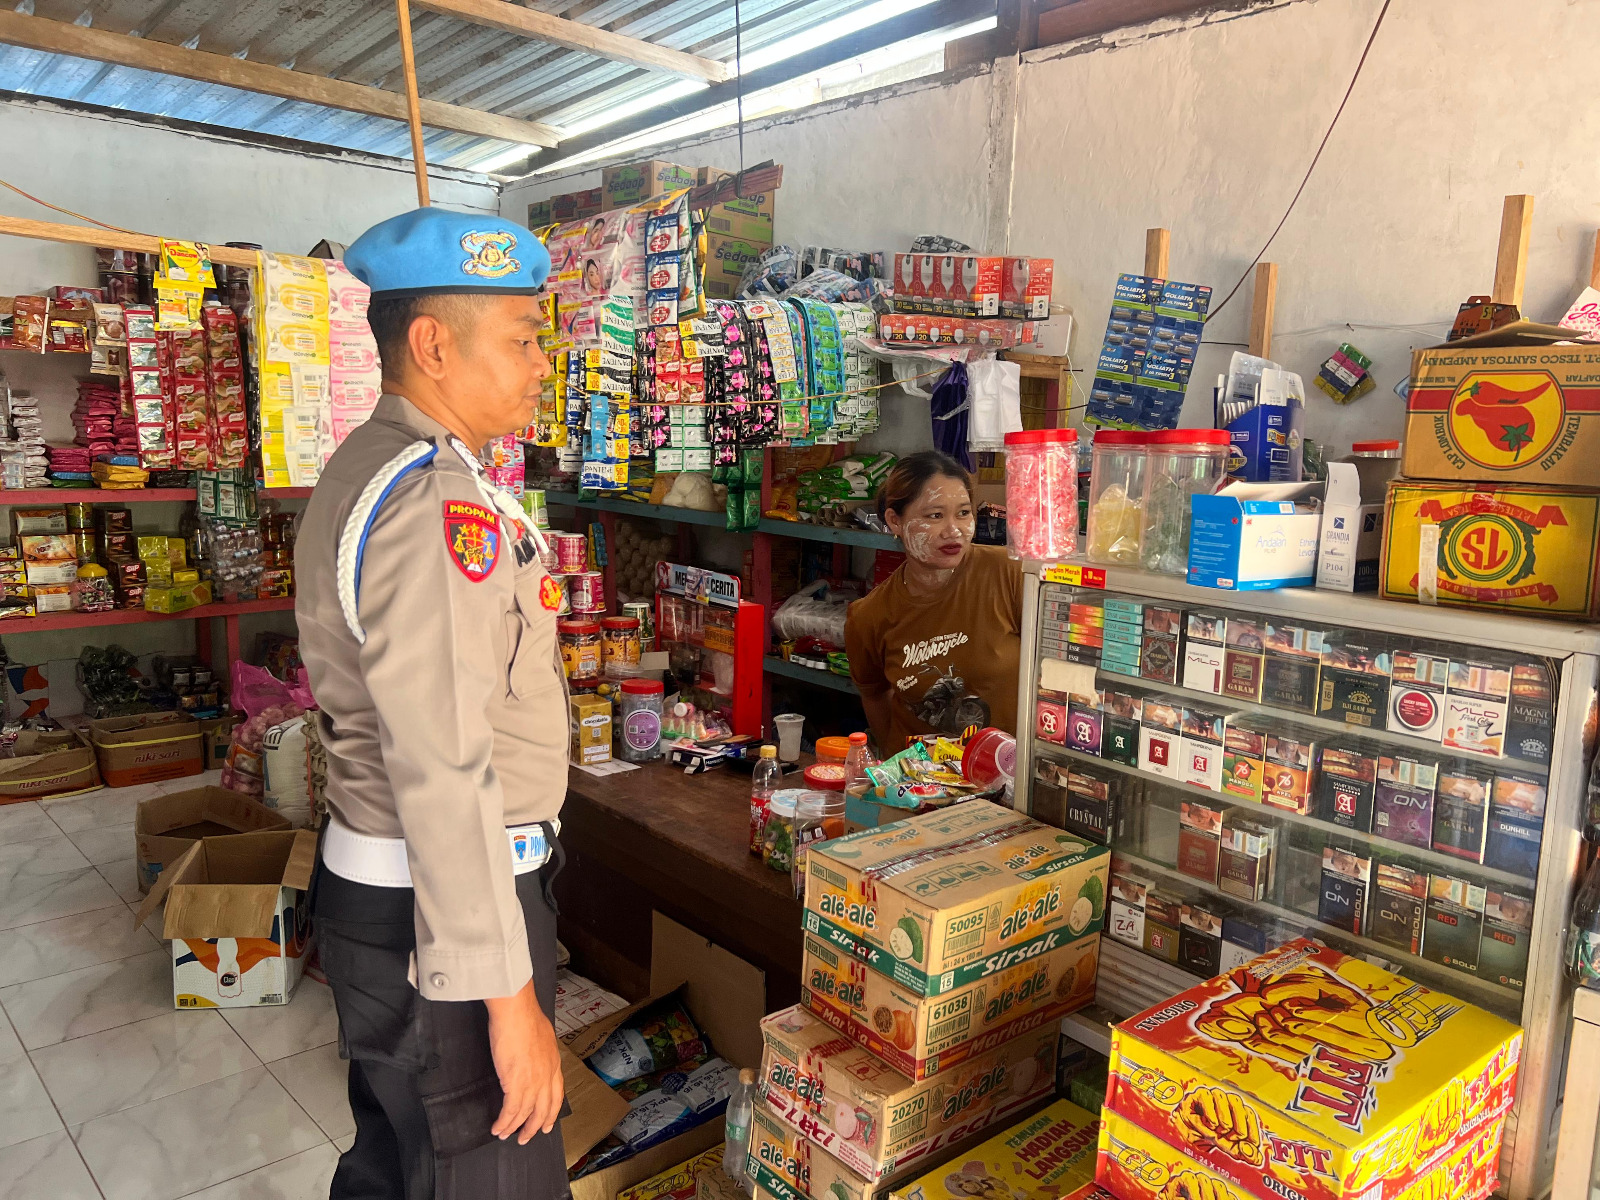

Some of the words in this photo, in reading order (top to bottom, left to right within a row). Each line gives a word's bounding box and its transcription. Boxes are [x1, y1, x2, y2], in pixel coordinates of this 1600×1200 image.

[1424, 356, 1478, 366] AMPENAN
[1481, 355, 1537, 365] SANTOSA
[1540, 353, 1581, 365] TESCO
[1433, 415, 1451, 455] LOMBOK
[1540, 416, 1581, 472] TEMBAKAU
[584, 465, 614, 474] PANTENE
[448, 504, 496, 525] PROPAM
[1325, 563, 1344, 572] P104
[710, 577, 735, 599] CERITA
[1227, 682, 1255, 694] GARAM
[1450, 704, 1499, 719] MLD
[134, 750, 156, 763] niki
[158, 749, 181, 761] sari
[1235, 763, 1248, 776] 76
[1278, 774, 1292, 788] 76
[1333, 781, 1361, 793] SAMPOERNA
[1276, 790, 1292, 799] APEL
[1393, 793, 1428, 810] ON
[1069, 807, 1104, 830] CRYSTAL
[1500, 823, 1531, 837] DUNHILL
[1325, 890, 1350, 907] ON
[1354, 888, 1363, 918] BOLD
[808, 917, 818, 931] 15
[948, 912, 985, 936] 50095
[1380, 908, 1407, 925] ON
[1412, 905, 1422, 937] BOLD
[1437, 912, 1458, 926] RED
[1493, 930, 1515, 945] RED
[1452, 958, 1477, 971] BOLD
[941, 977, 952, 989] 15
[933, 995, 968, 1020] 61038
[1133, 999, 1199, 1033] ORIGINAL
[967, 1010, 1046, 1057] Markisa
[925, 1062, 938, 1074] 15
[1467, 1044, 1505, 1109] FIT
[1130, 1065, 1186, 1106] GO
[1299, 1045, 1376, 1128] FIT
[891, 1097, 925, 1124] 20270
[925, 1106, 996, 1155] Leci
[1004, 1115, 1054, 1148] TEMUKAN
[1014, 1119, 1077, 1163] HADIAH
[1268, 1135, 1333, 1176] FIT
[1452, 1129, 1490, 1189] FIT
[749, 1162, 759, 1176] 15
[882, 1162, 894, 1175] 15
[1116, 1145, 1172, 1187] GO
[1183, 1146, 1196, 1158] ISI
[1199, 1155, 1209, 1167] 24
[1215, 1163, 1231, 1179] 150
[1230, 1172, 1242, 1186] ml
